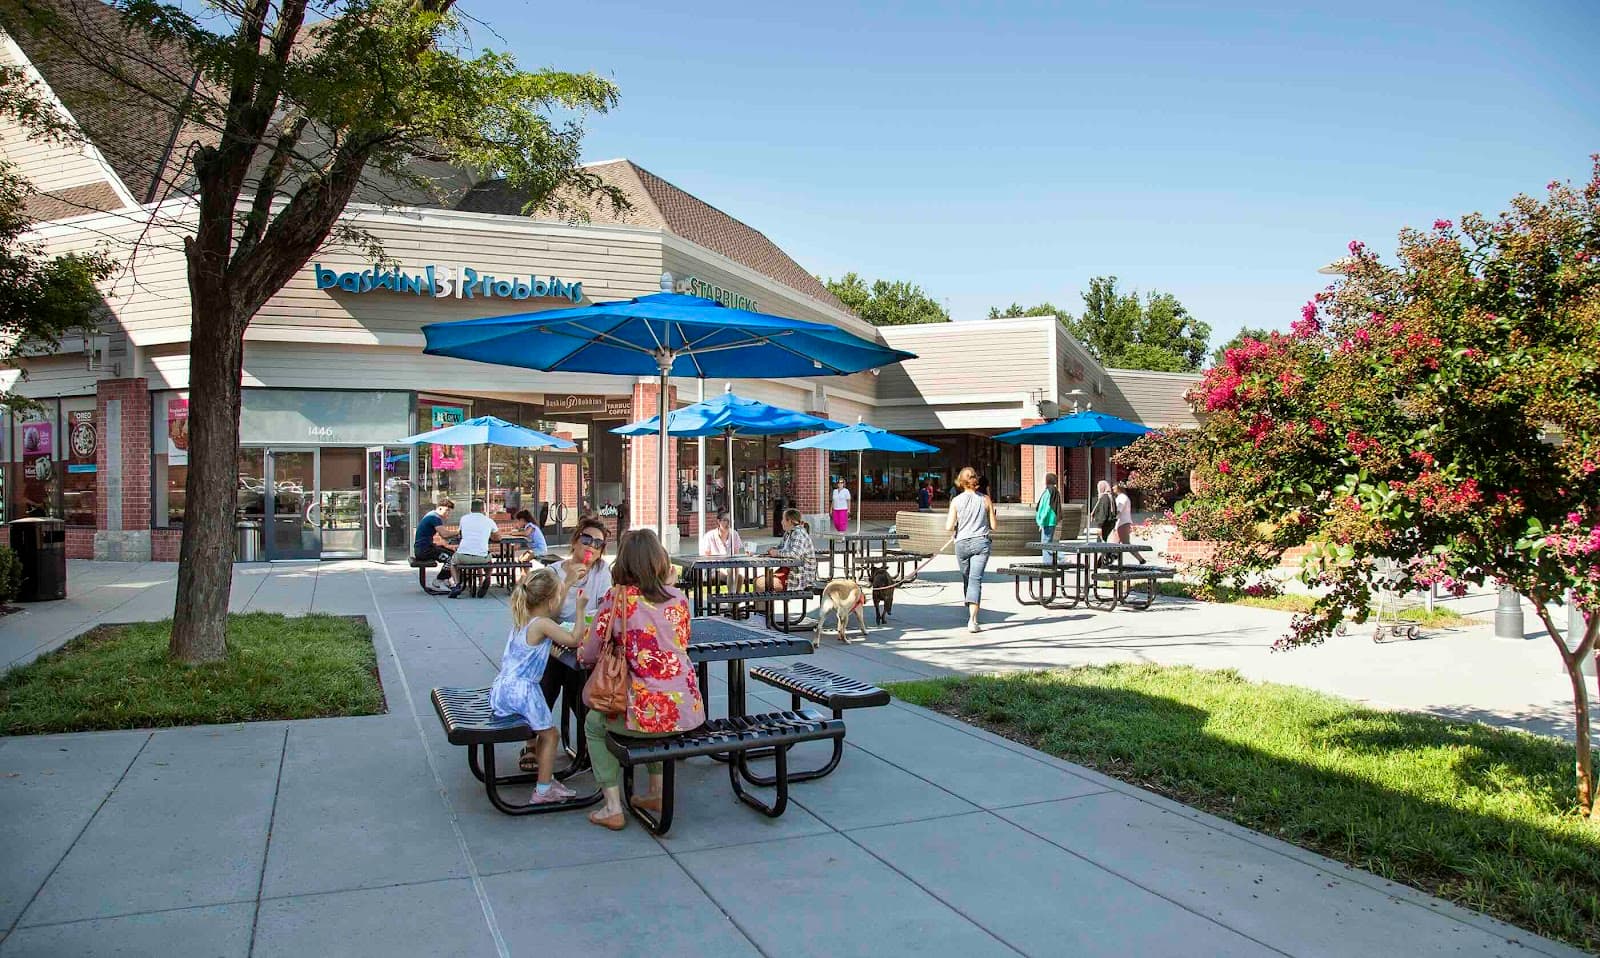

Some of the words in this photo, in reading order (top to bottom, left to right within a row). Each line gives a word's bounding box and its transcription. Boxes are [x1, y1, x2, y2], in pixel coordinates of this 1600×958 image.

[315, 263, 421, 296] baskin
[481, 275, 583, 304] robbins
[690, 277, 759, 312] STARBUCKS
[308, 426, 333, 436] 1446
